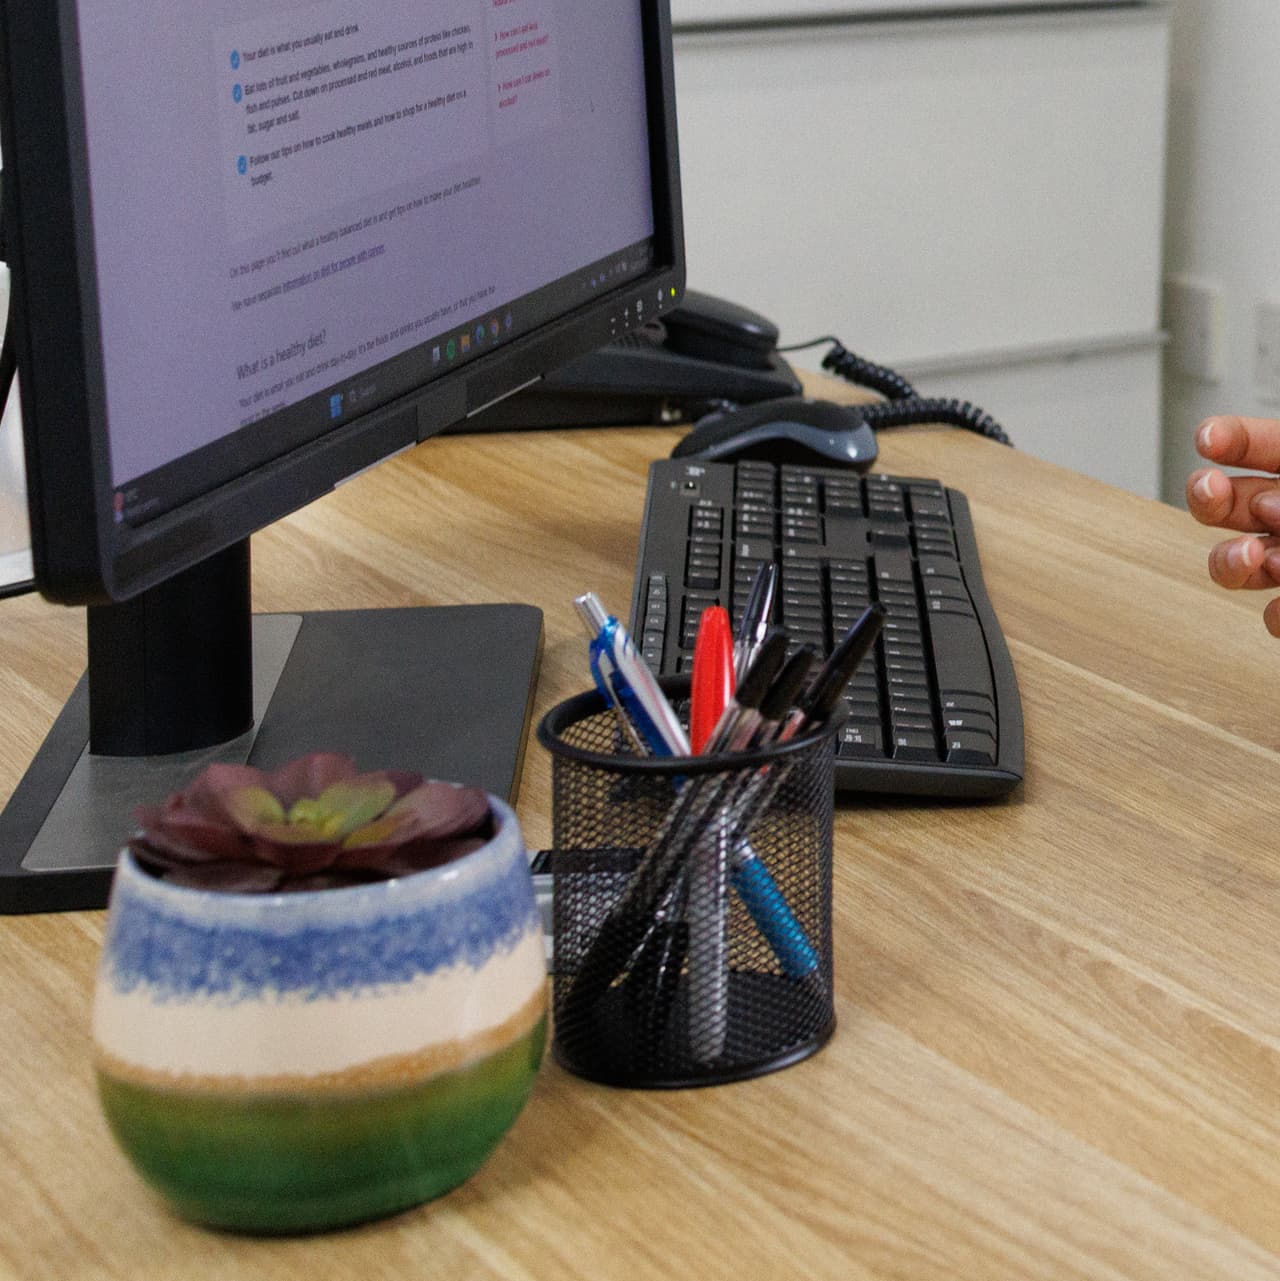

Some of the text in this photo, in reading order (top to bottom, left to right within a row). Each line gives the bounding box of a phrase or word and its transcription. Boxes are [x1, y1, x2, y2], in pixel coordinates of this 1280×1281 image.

[242, 51, 256, 62] Your
[257, 46, 269, 59] diet
[269, 45, 275, 56] is
[276, 40, 290, 54] what
[291, 39, 302, 52] you
[302, 33, 323, 47] usually
[323, 30, 332, 42] eat
[333, 27, 344, 39] and
[236, 329, 326, 381] What is a healthy diet?
